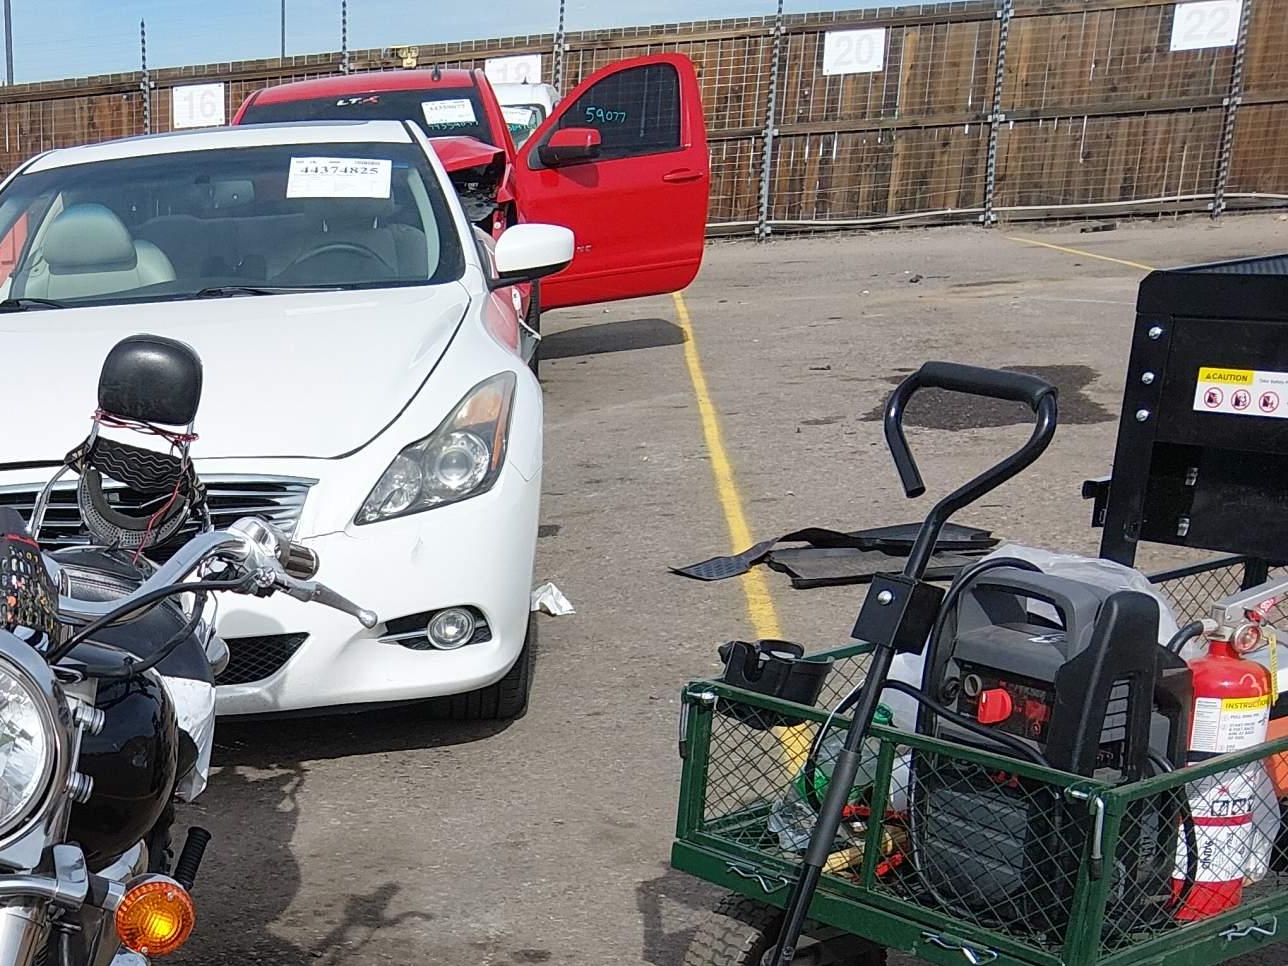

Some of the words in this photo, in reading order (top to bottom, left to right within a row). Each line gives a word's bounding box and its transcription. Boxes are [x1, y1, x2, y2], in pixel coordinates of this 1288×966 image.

[1183, 7, 1230, 42] 22
[833, 34, 874, 66] 20
[183, 90, 217, 121] 16
[585, 107, 627, 125] 59077
[299, 166, 379, 175] 44374825
[1212, 373, 1248, 382] CAUTION
